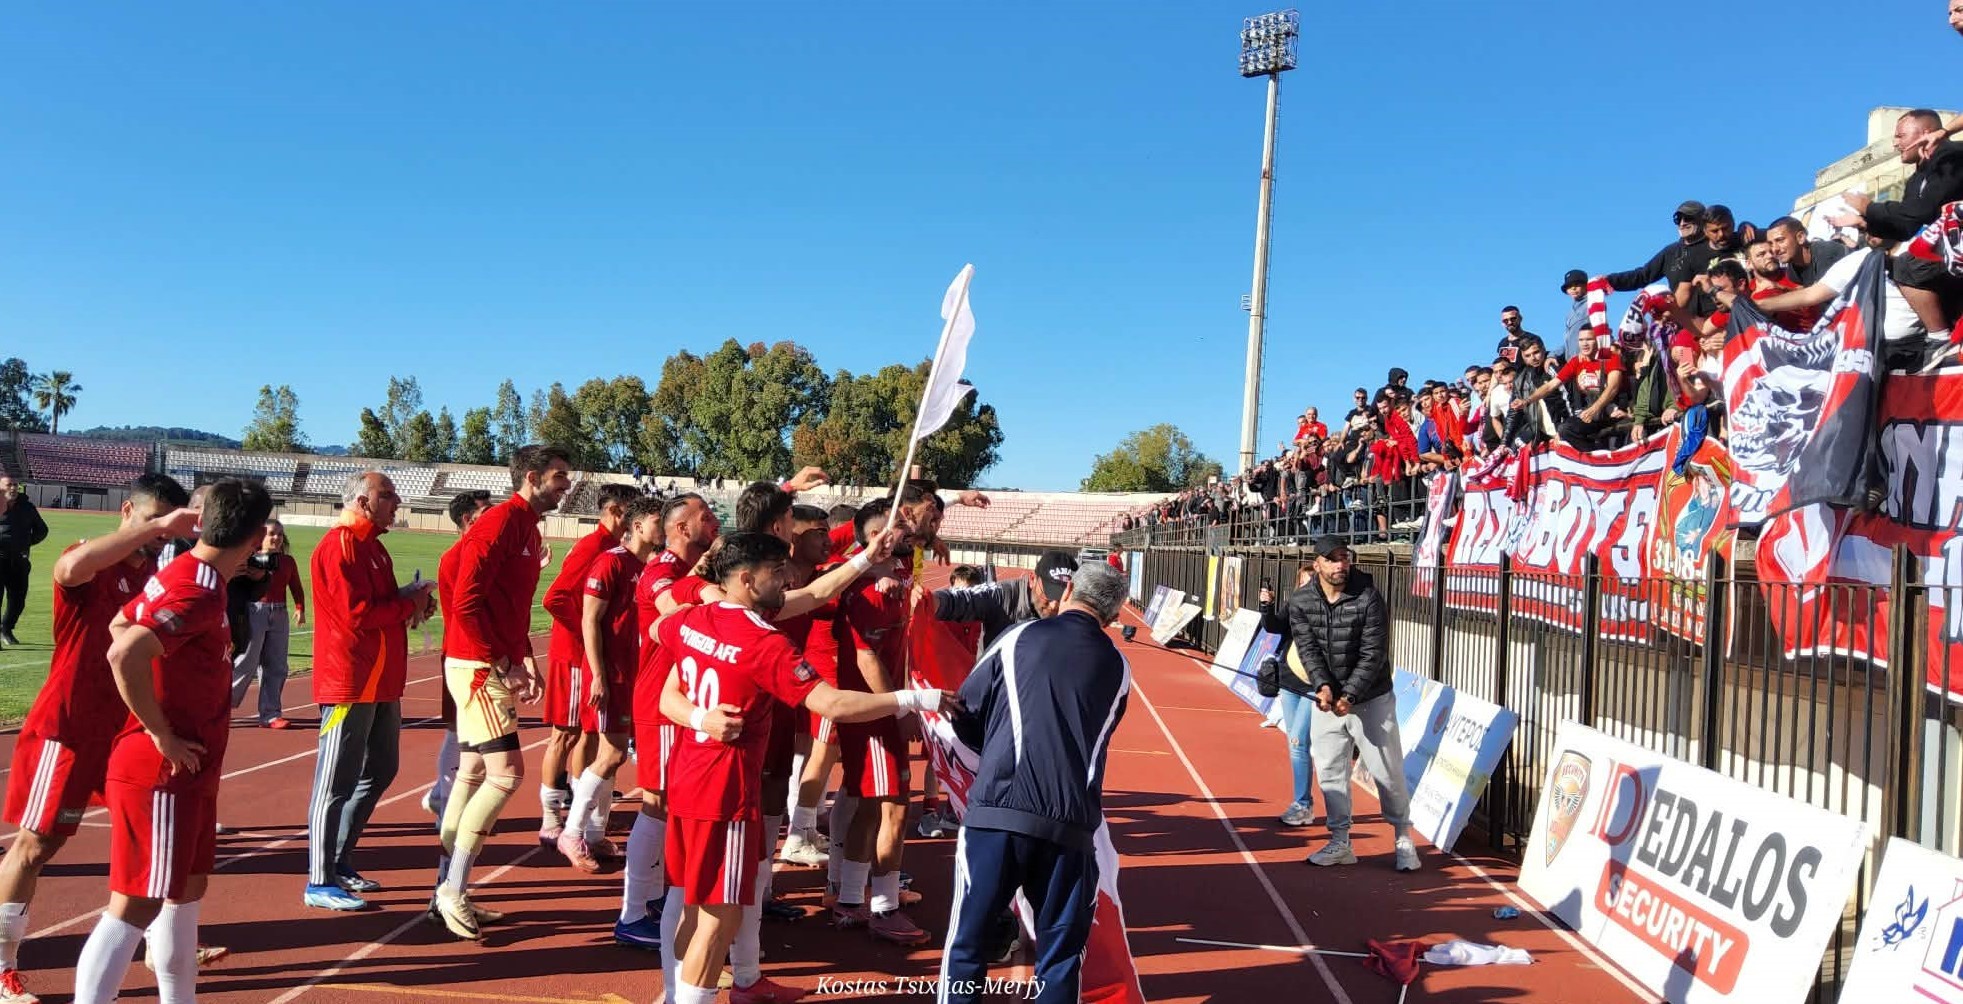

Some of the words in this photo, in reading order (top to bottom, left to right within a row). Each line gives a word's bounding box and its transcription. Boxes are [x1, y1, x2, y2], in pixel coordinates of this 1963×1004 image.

[1540, 478, 1657, 584] BOYS
[713, 643, 742, 664] AFC
[1604, 872, 1737, 976] SECURITY
